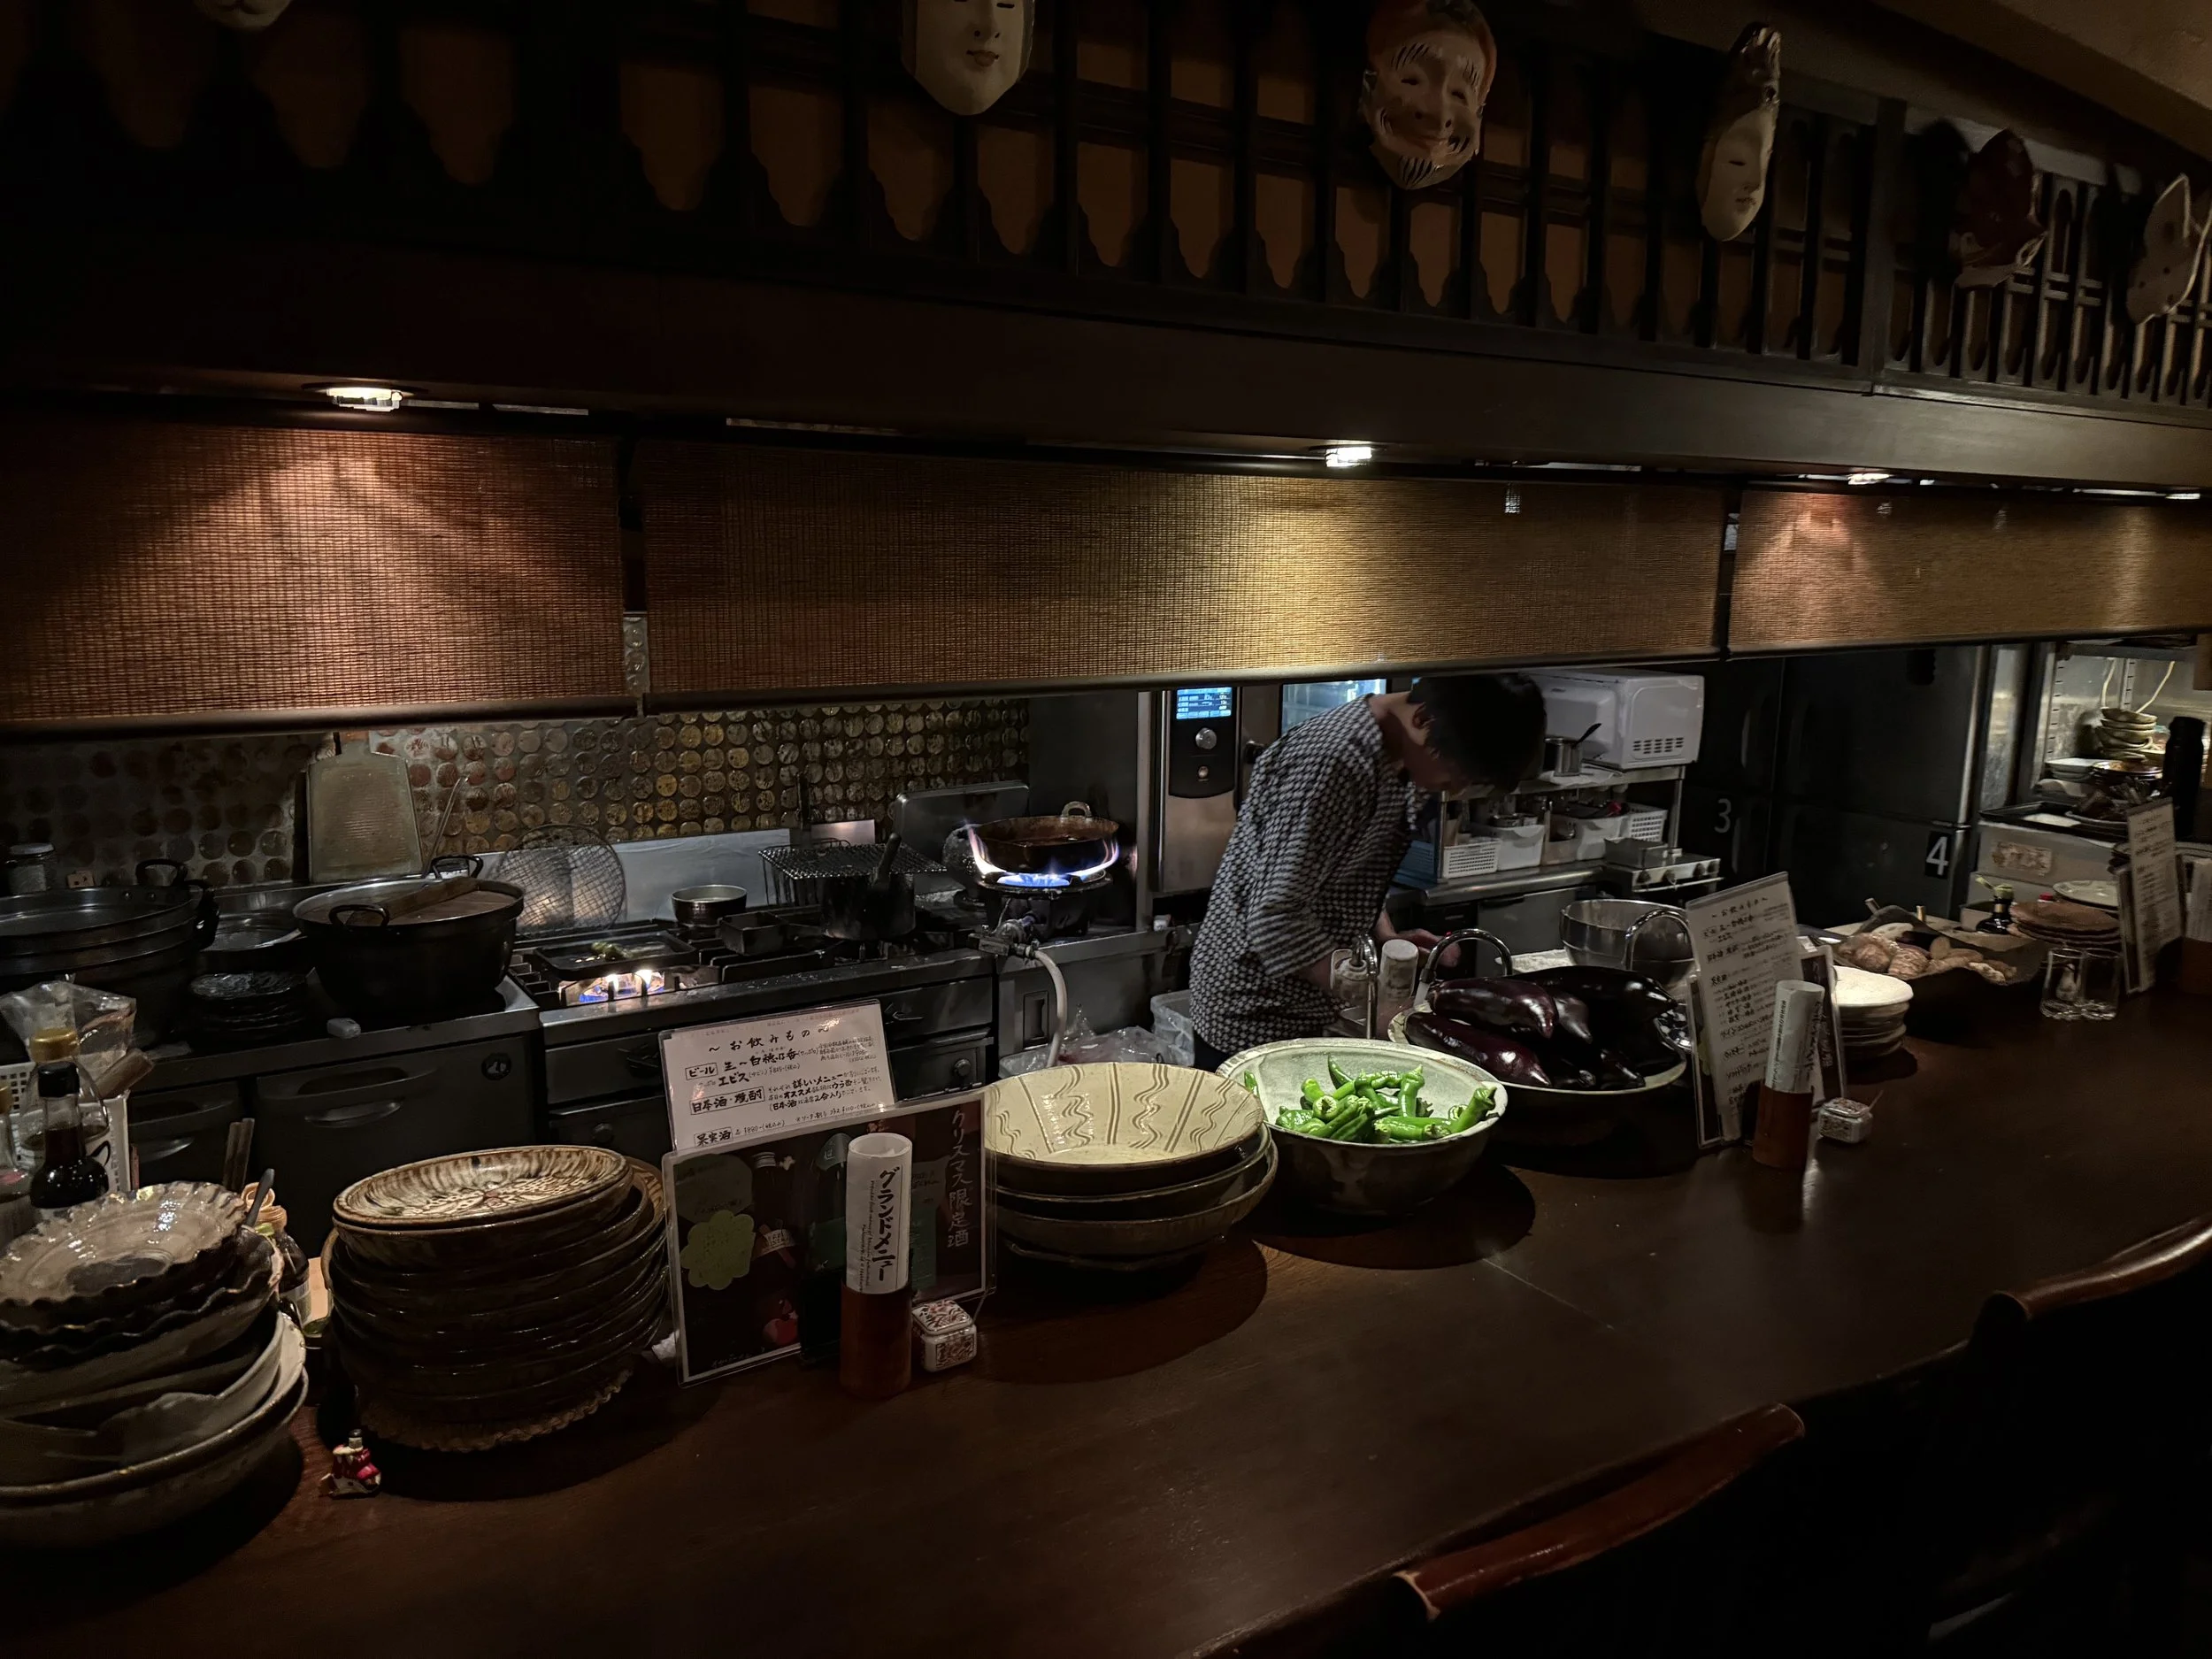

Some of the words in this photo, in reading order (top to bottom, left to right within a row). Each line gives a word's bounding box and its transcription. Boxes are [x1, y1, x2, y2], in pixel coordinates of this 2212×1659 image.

[1714, 798, 1732, 833] 3
[1925, 836, 1949, 876] 4
[688, 1065, 716, 1078] ビール
[695, 1130, 732, 1148] 果実酒
[947, 1109, 974, 1248] クリスマス限定酒
[872, 1165, 901, 1282] グランドメニュー
